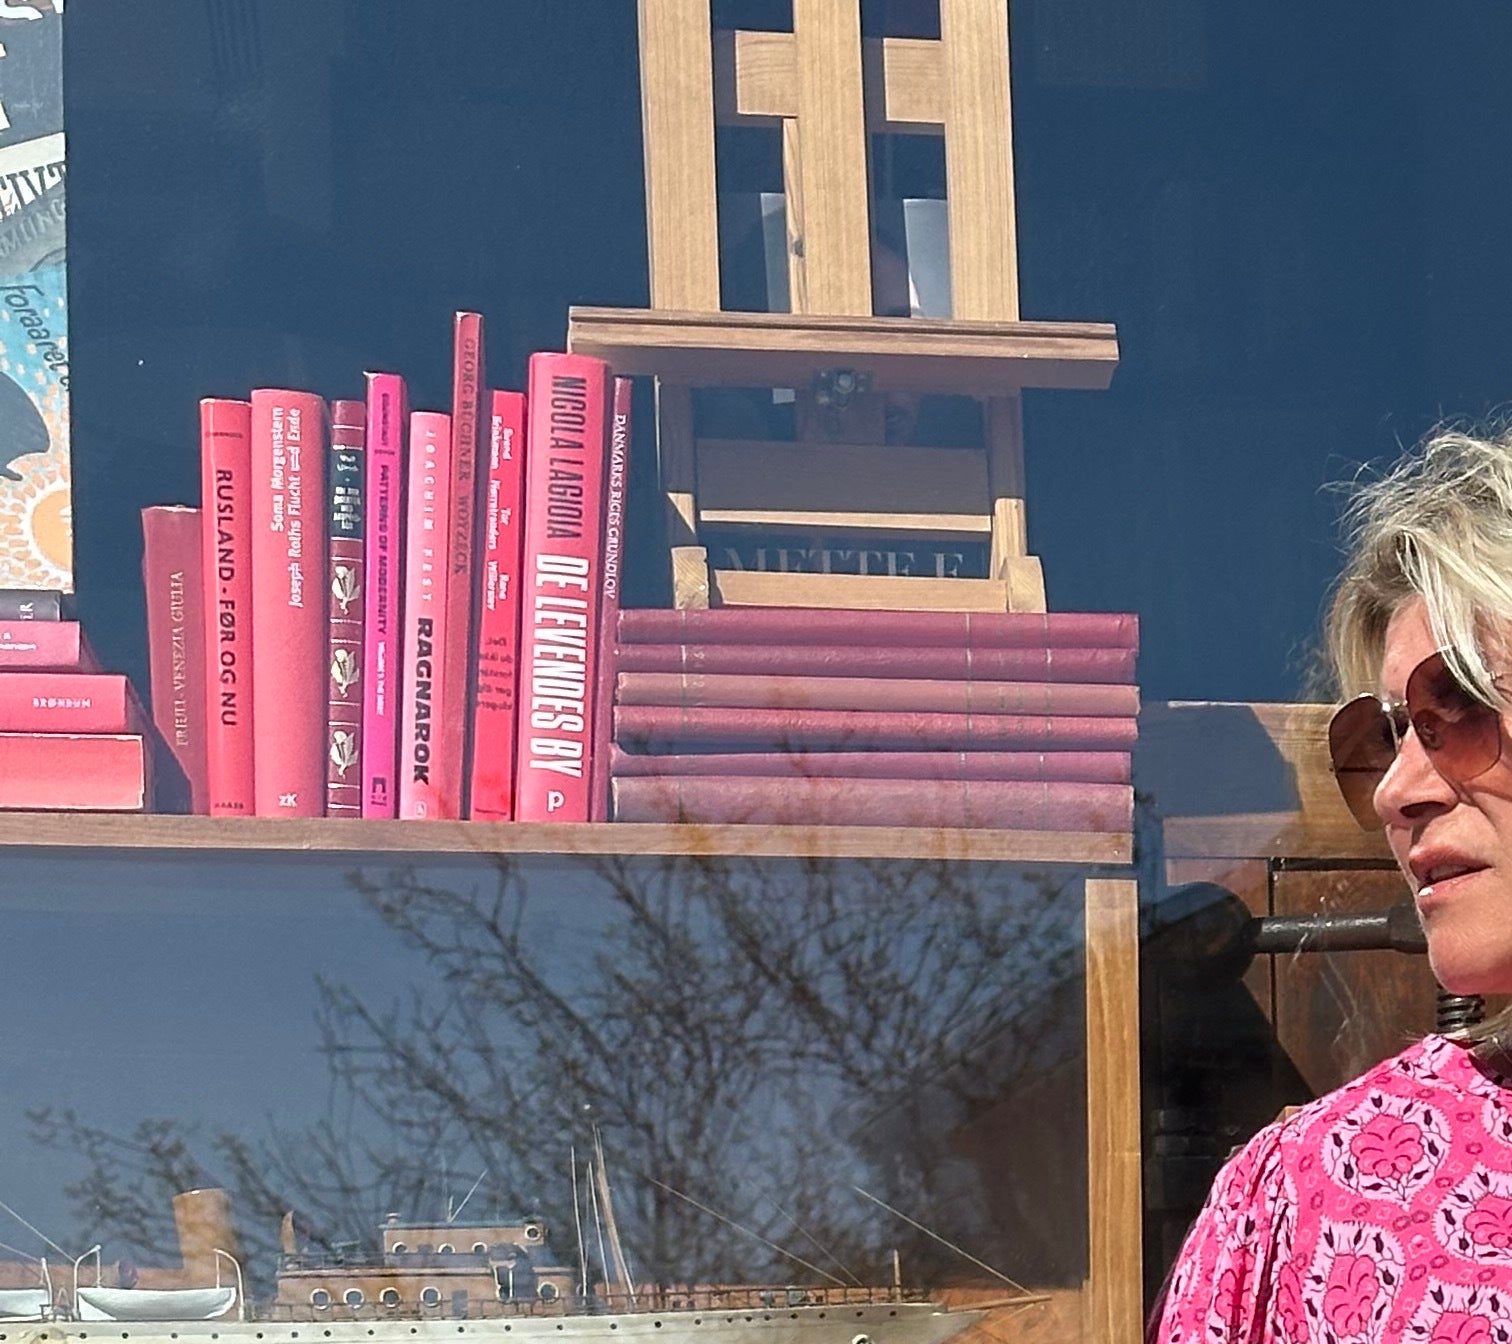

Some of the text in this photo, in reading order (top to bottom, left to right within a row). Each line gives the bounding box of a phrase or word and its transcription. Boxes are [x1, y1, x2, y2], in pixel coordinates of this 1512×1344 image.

[547, 376, 587, 540] NICOLA LAGIOIA
[610, 414, 627, 489] DANMARKS
[216, 469, 235, 582] RUSLAND
[219, 599, 236, 643] FØR
[220, 651, 237, 685] OG
[529, 554, 590, 779] DE LEVENDES BY
[220, 691, 237, 726] NU
[413, 617, 434, 786] RAGNAROK
